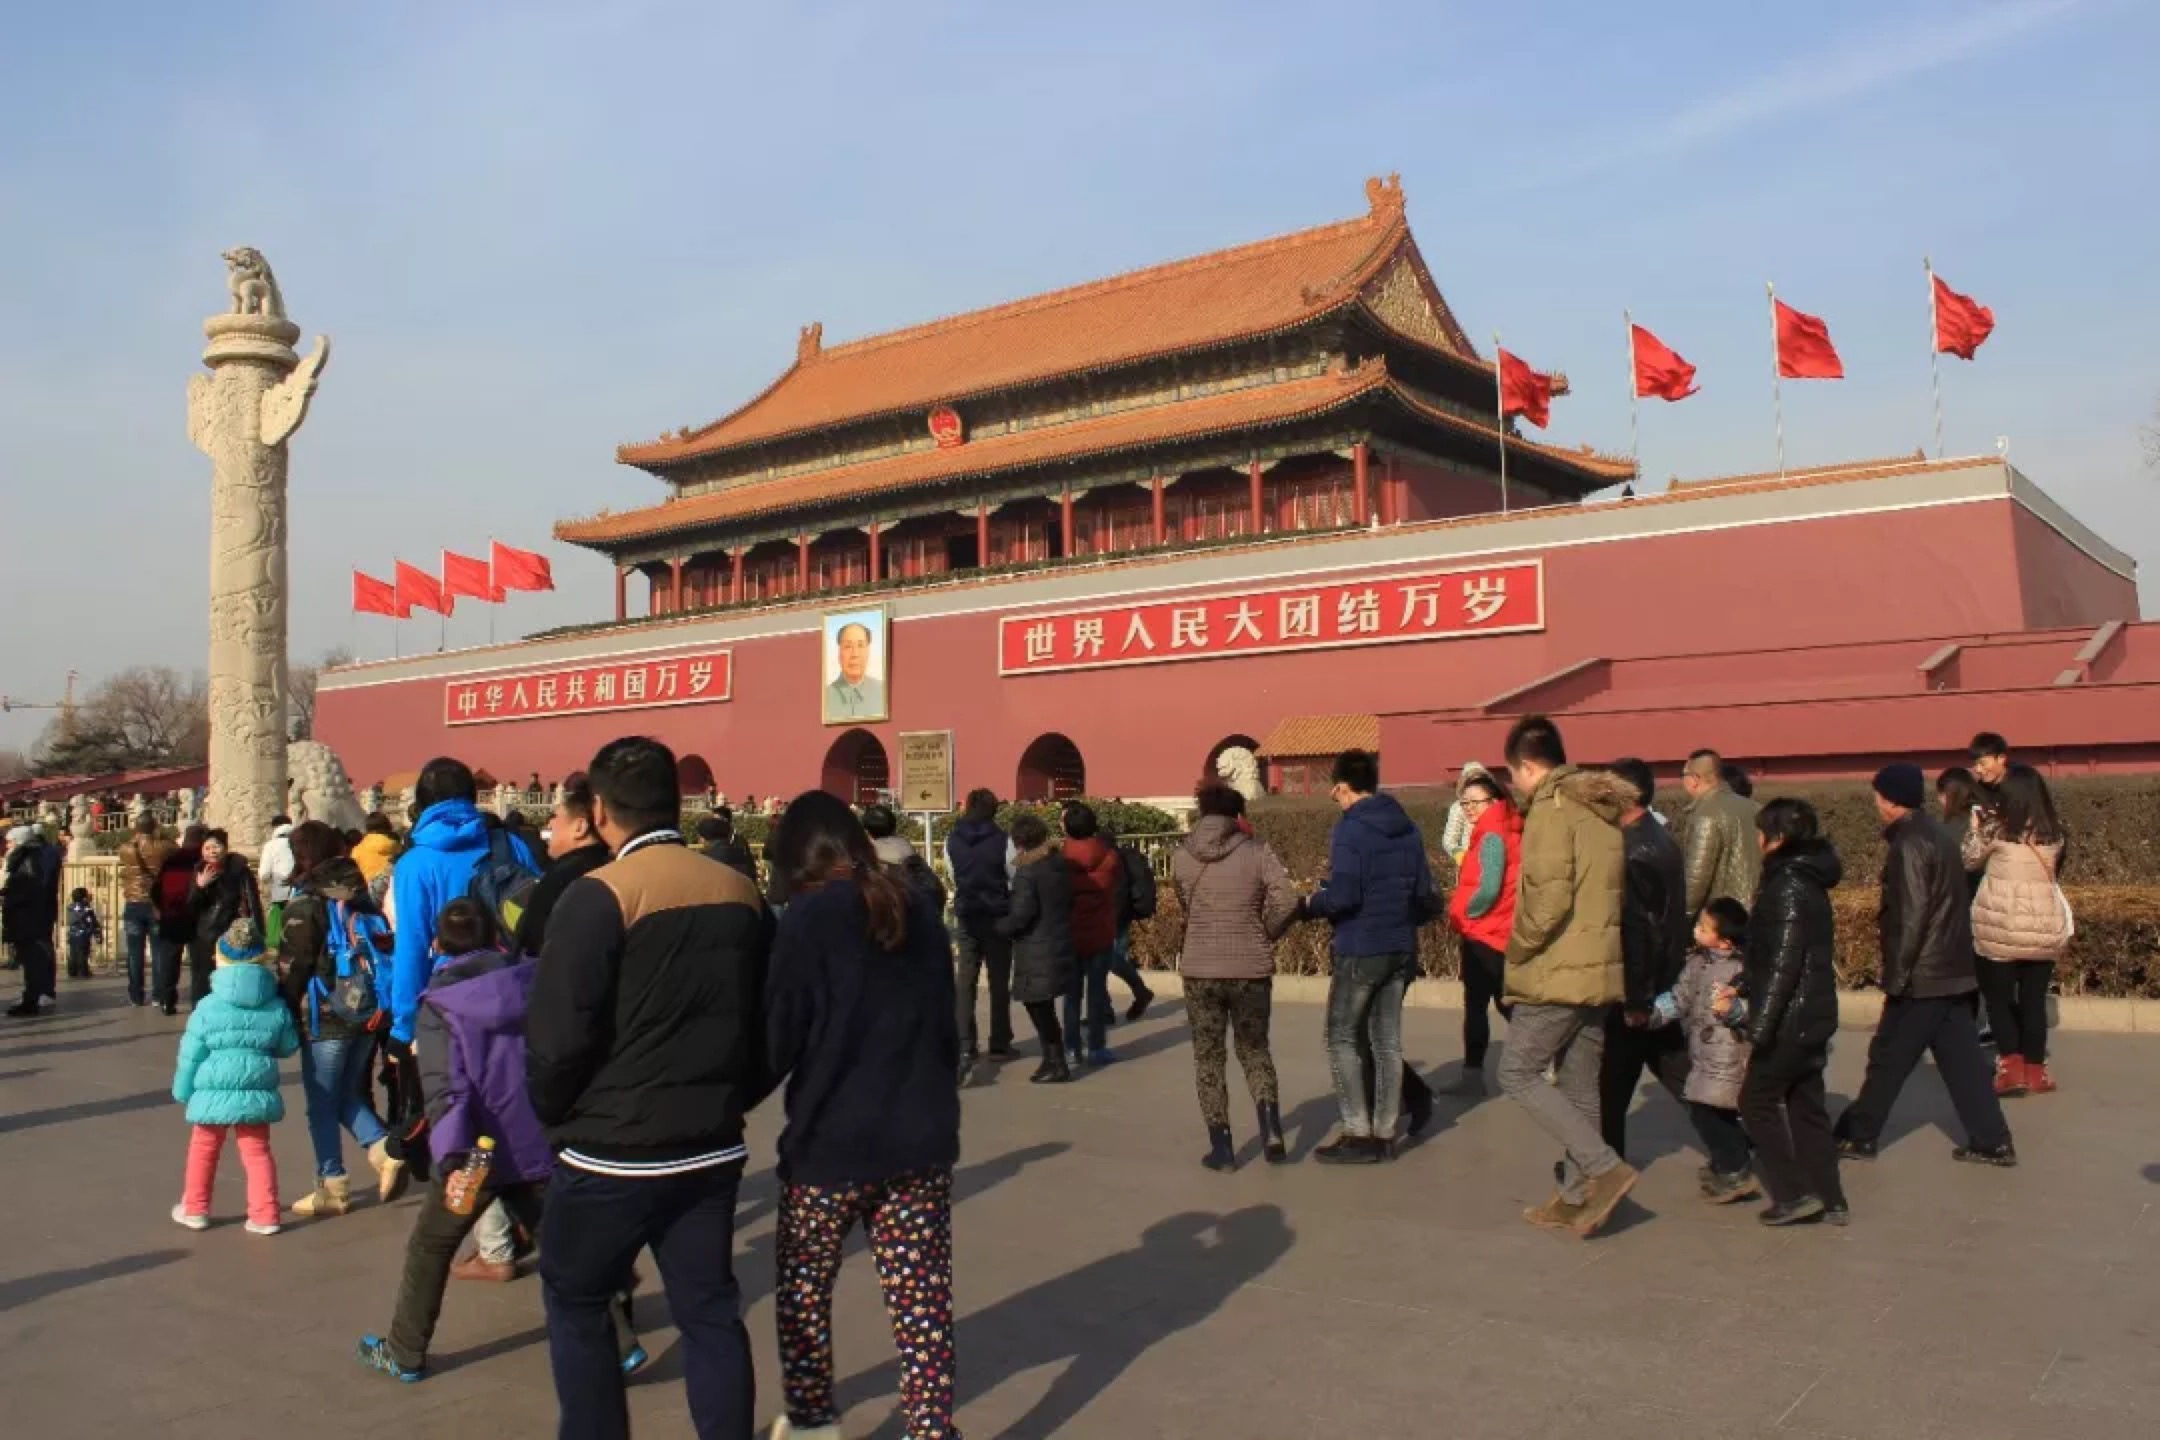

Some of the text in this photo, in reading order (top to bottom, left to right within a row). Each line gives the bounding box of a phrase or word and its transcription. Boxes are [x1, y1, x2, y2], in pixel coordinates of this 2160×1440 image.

[1023, 577, 1508, 662] 世界人民大团结万岁
[458, 661, 713, 716] 中华人民共和国万岁
